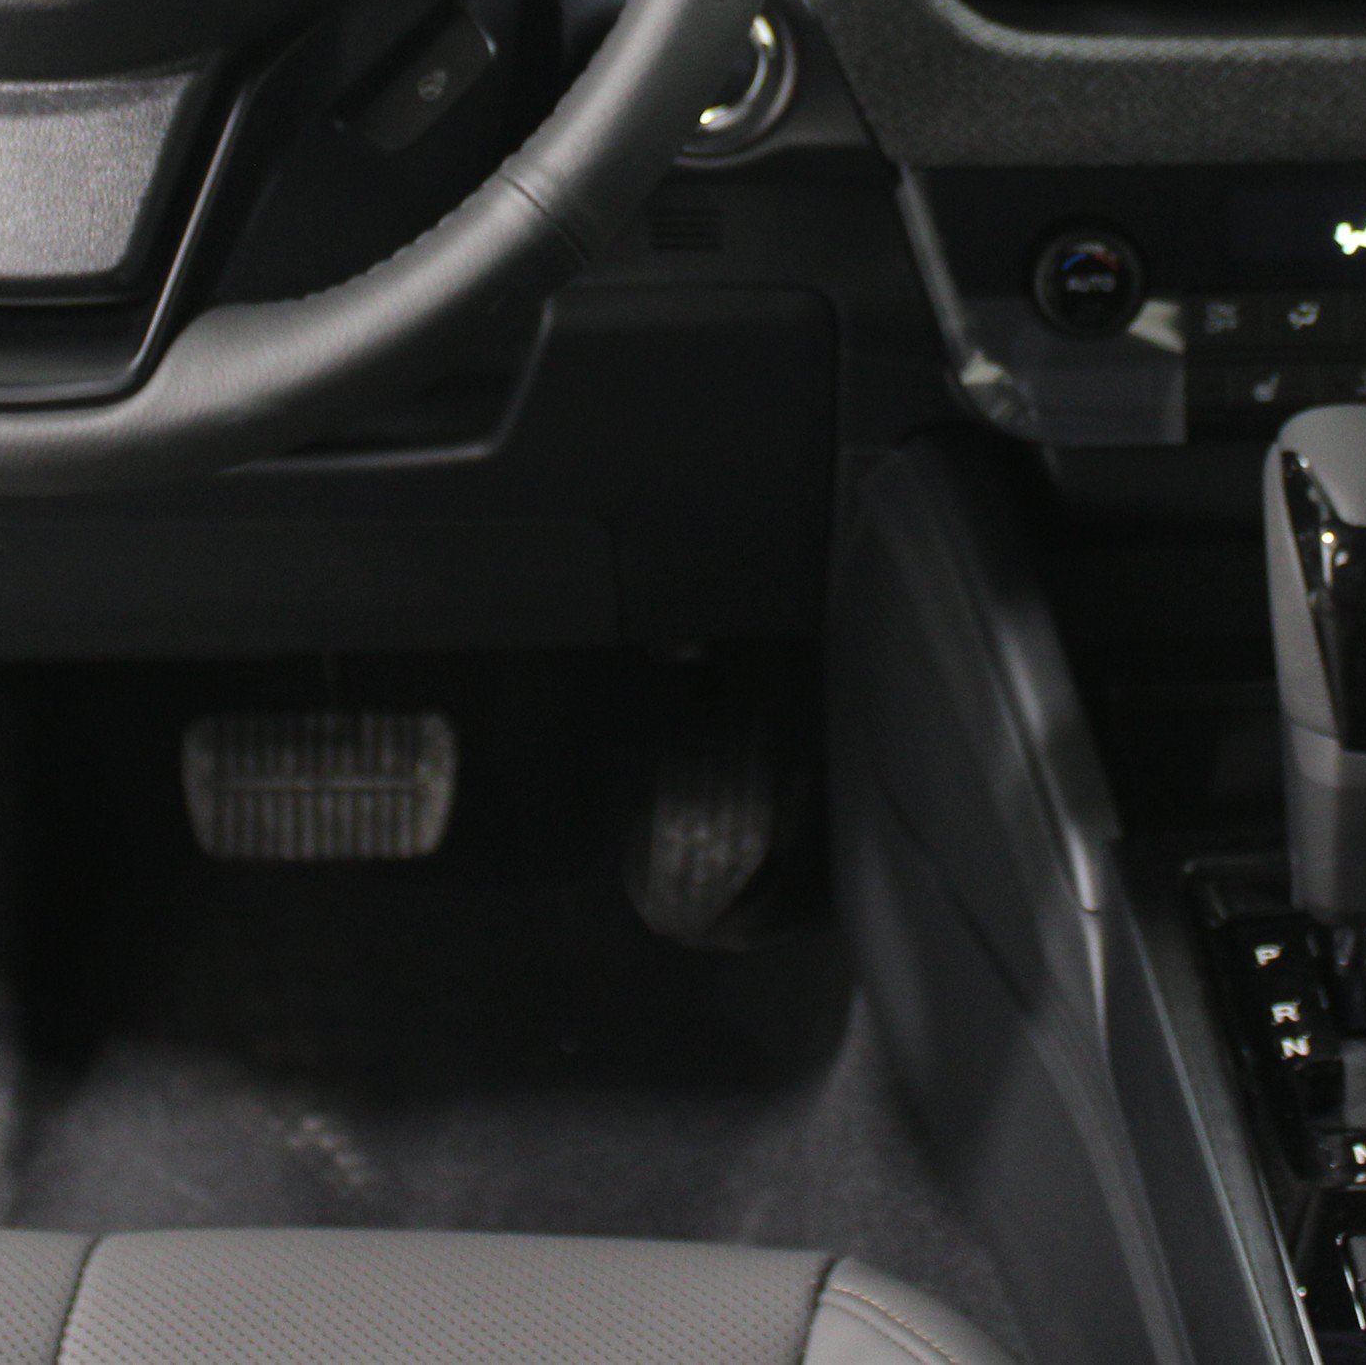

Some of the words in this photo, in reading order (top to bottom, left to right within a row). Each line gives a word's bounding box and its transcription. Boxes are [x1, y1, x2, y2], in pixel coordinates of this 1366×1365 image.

[1255, 944, 1281, 966] P
[1271, 1002, 1300, 1023] R
[1281, 1036, 1310, 1058] N
